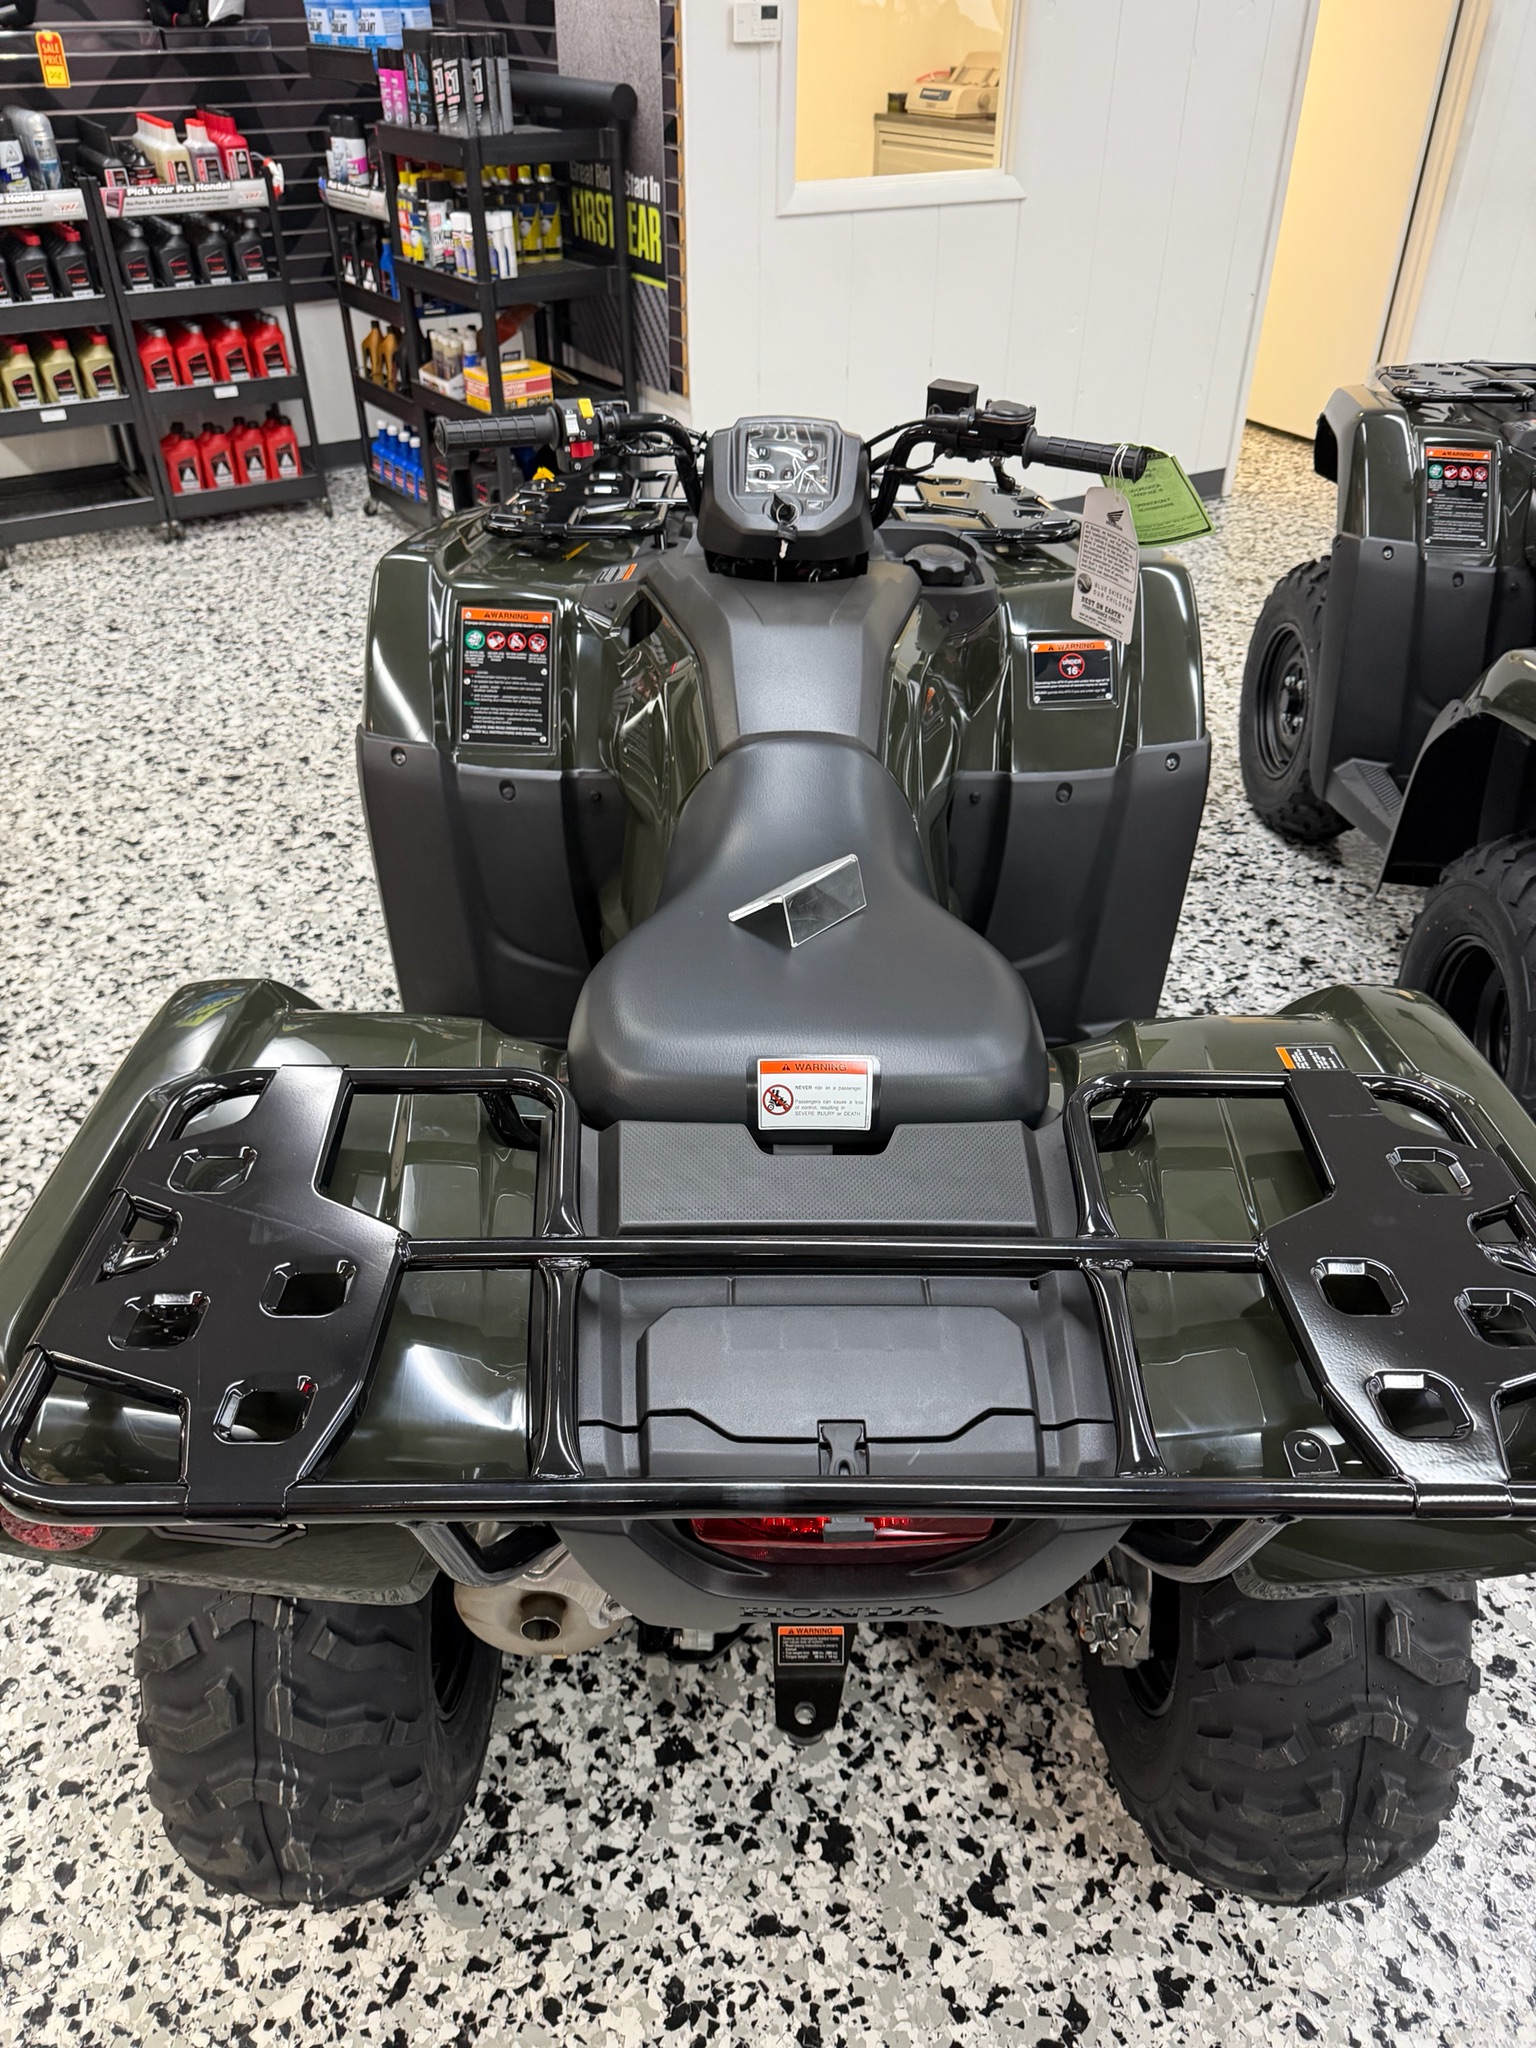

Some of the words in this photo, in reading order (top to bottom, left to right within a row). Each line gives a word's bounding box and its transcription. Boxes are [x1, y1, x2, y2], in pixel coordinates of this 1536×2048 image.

[42, 42, 60, 54] SALE
[44, 54, 64, 65] PRICE
[570, 160, 594, 186] Great
[624, 170, 648, 200] Start
[650, 176, 660, 204] In
[127, 186, 150, 196] Pick
[151, 184, 174, 195] Your
[176, 184, 194, 193] Pro
[196, 182, 230, 192] Honda!
[6, 192, 44, 204] Honda!
[570, 186, 615, 250] FIRST
[626, 201, 662, 264] EAR
[1094, 582, 1107, 592] BLUE
[1109, 589, 1122, 599] SKIES
[1081, 596, 1095, 606] BEST
[1093, 590, 1104, 598] OUR
[1106, 595, 1132, 612] CHILDREN
[491, 612, 529, 620] WARNING
[739, 1606, 944, 1618] HONDA
